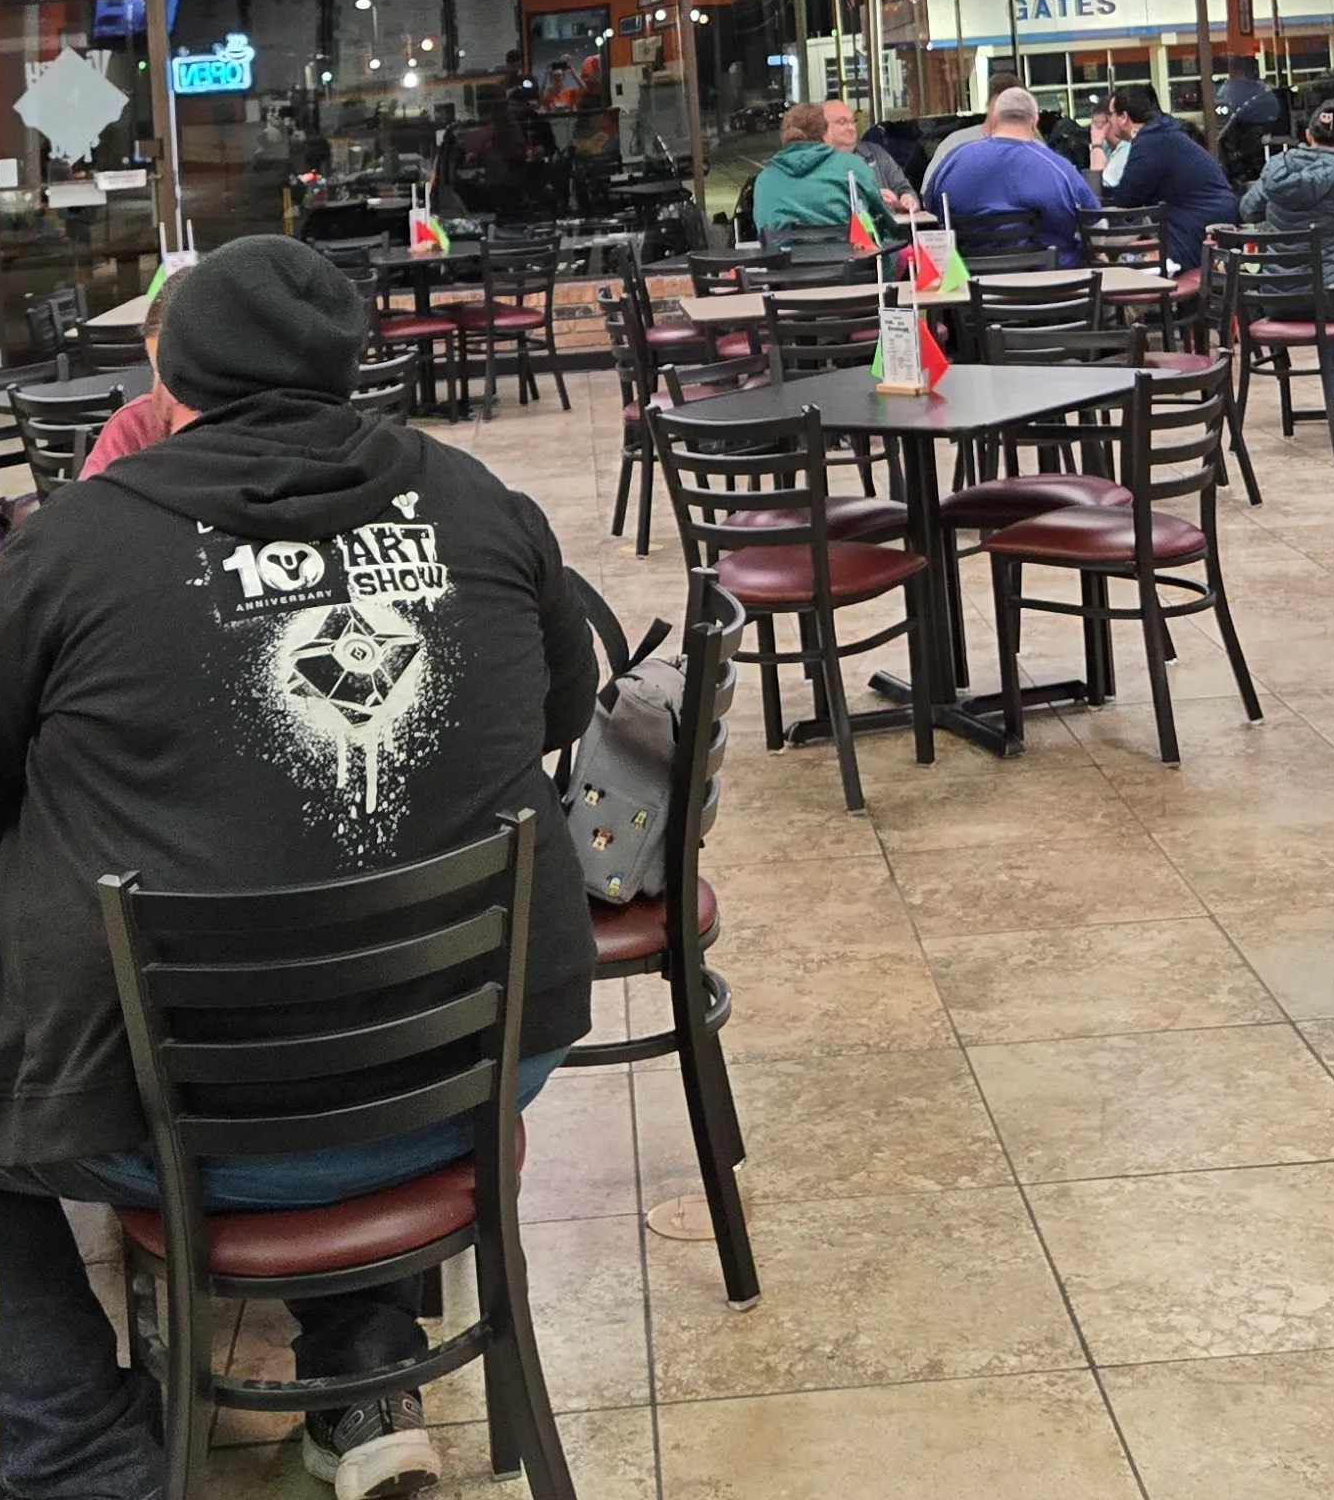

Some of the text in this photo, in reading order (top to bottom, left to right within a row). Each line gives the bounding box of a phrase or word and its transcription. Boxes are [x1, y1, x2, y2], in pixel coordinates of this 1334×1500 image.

[344, 524, 435, 570] ART
[353, 565, 444, 596] SHOW
[235, 589, 333, 612] ANNIVERSARY
